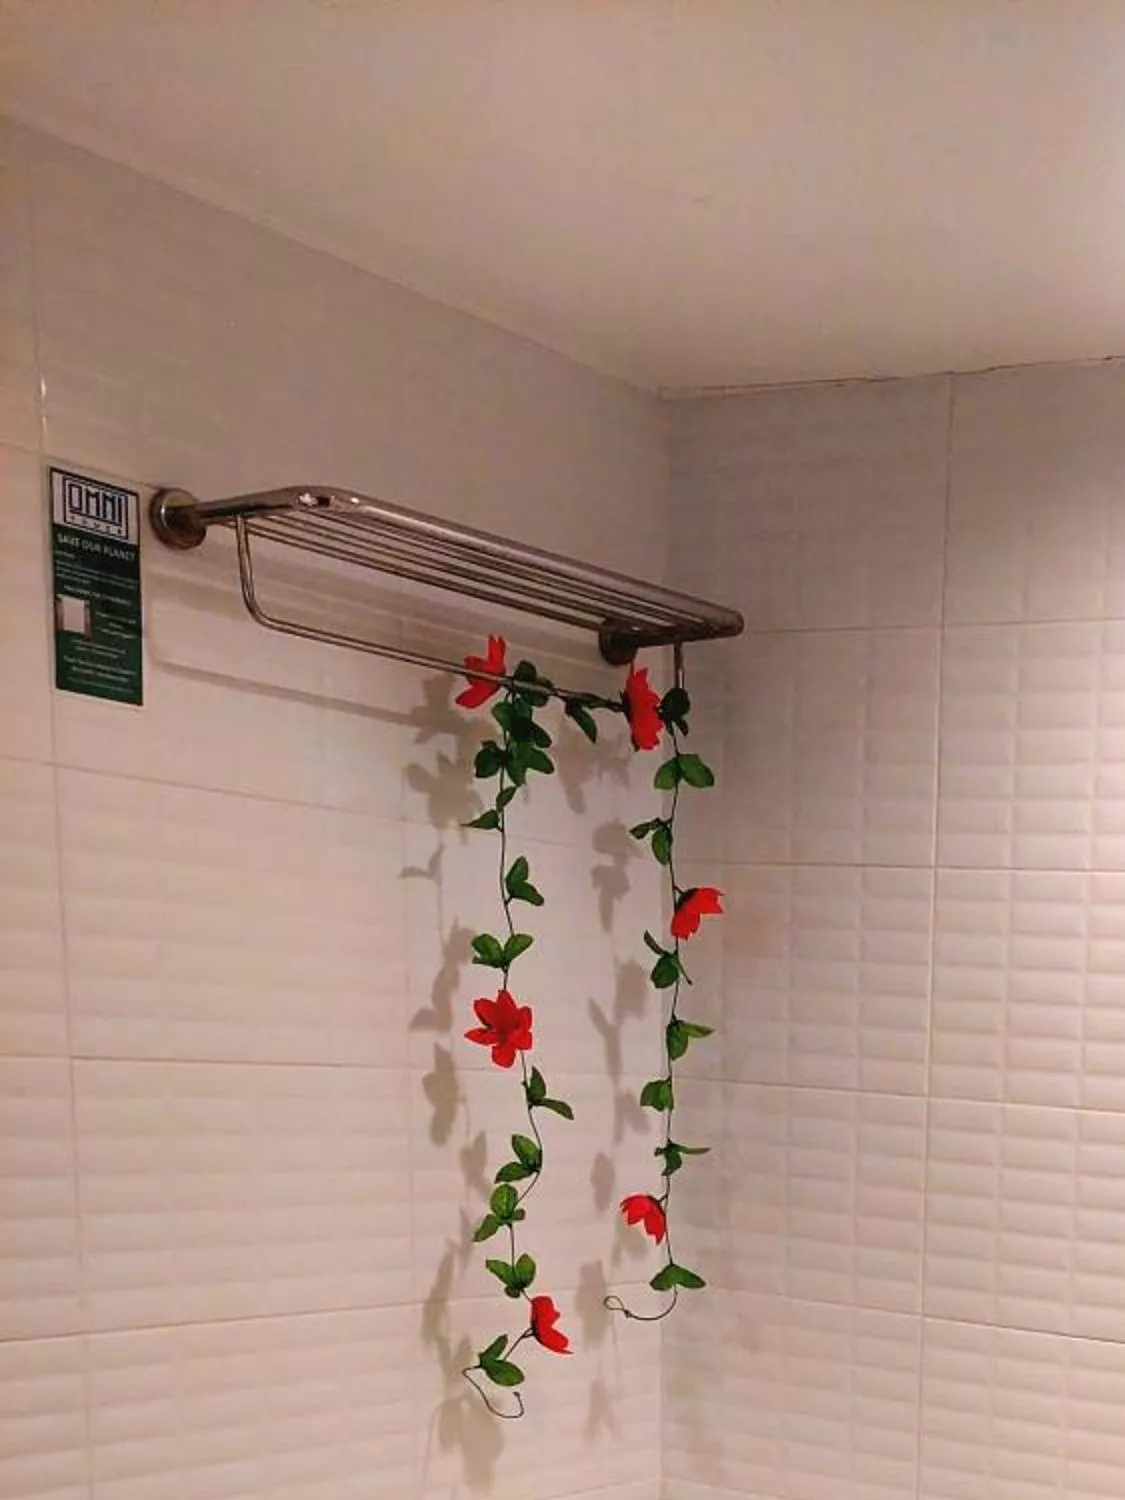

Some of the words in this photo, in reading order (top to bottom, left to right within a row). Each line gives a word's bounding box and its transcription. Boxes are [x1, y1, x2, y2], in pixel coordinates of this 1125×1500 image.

[67, 482, 122, 526] OMNI
[57, 532, 80, 547] SAVE
[82, 539, 102, 553] OUR
[103, 545, 136, 561] PLANET
